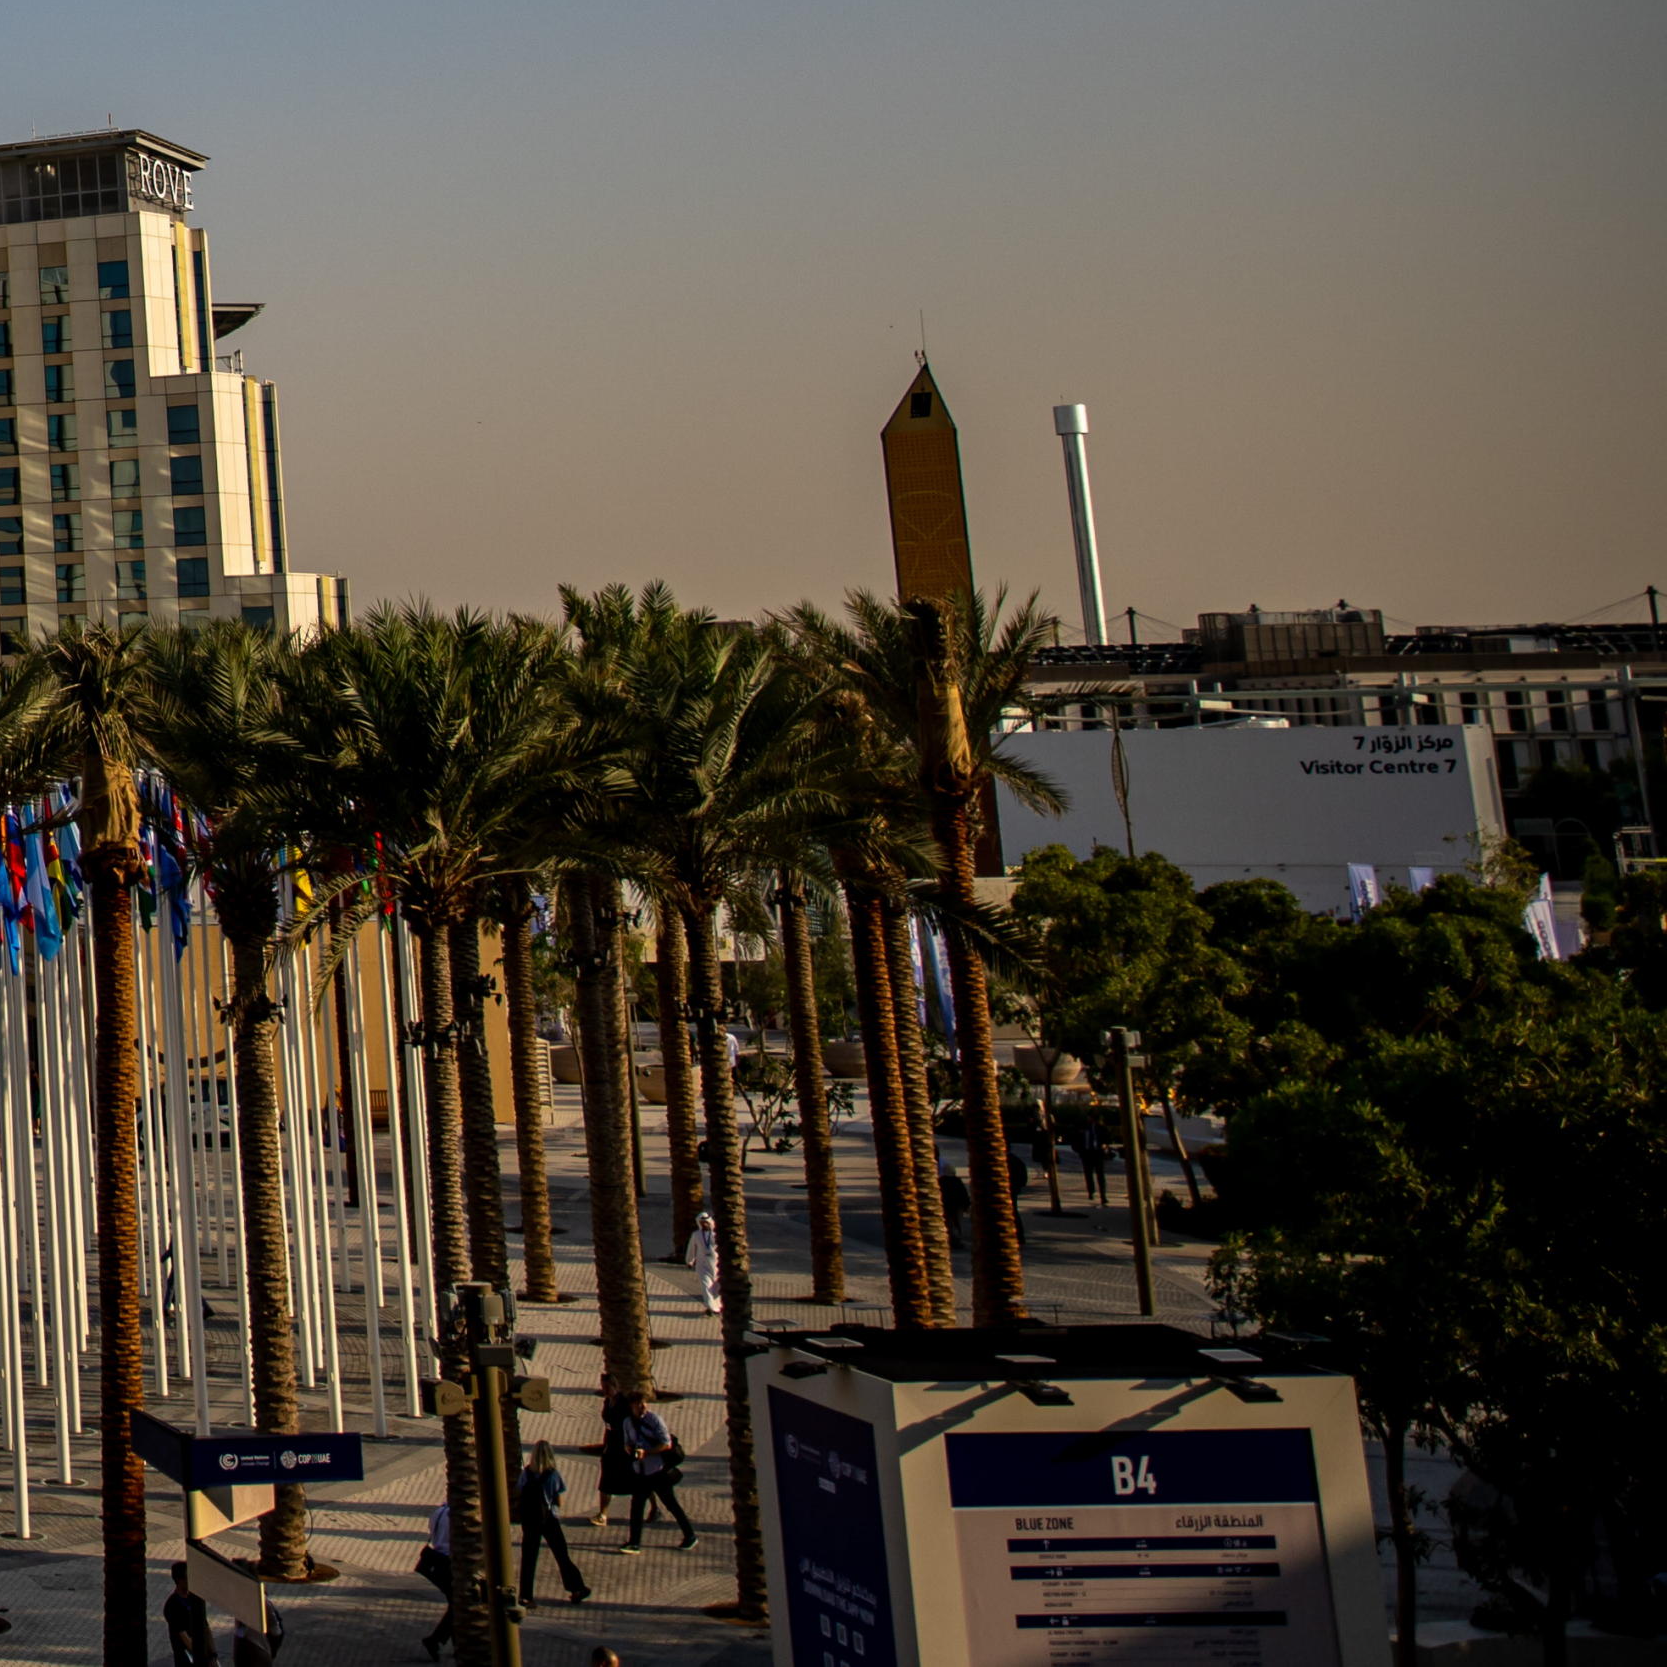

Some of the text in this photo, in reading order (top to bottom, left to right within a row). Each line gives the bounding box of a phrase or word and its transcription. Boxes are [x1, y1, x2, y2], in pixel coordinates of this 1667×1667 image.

[138, 153, 195, 211] ROVE
[1353, 736, 1365, 750] 7
[1417, 735, 1454, 753] مركز
[1300, 759, 1457, 775] Visitor Centre 7
[1111, 1455, 1157, 1496] B4
[1015, 1517, 1074, 1531] BLUE ZONE
[1214, 1515, 1263, 1528] المنطقة
